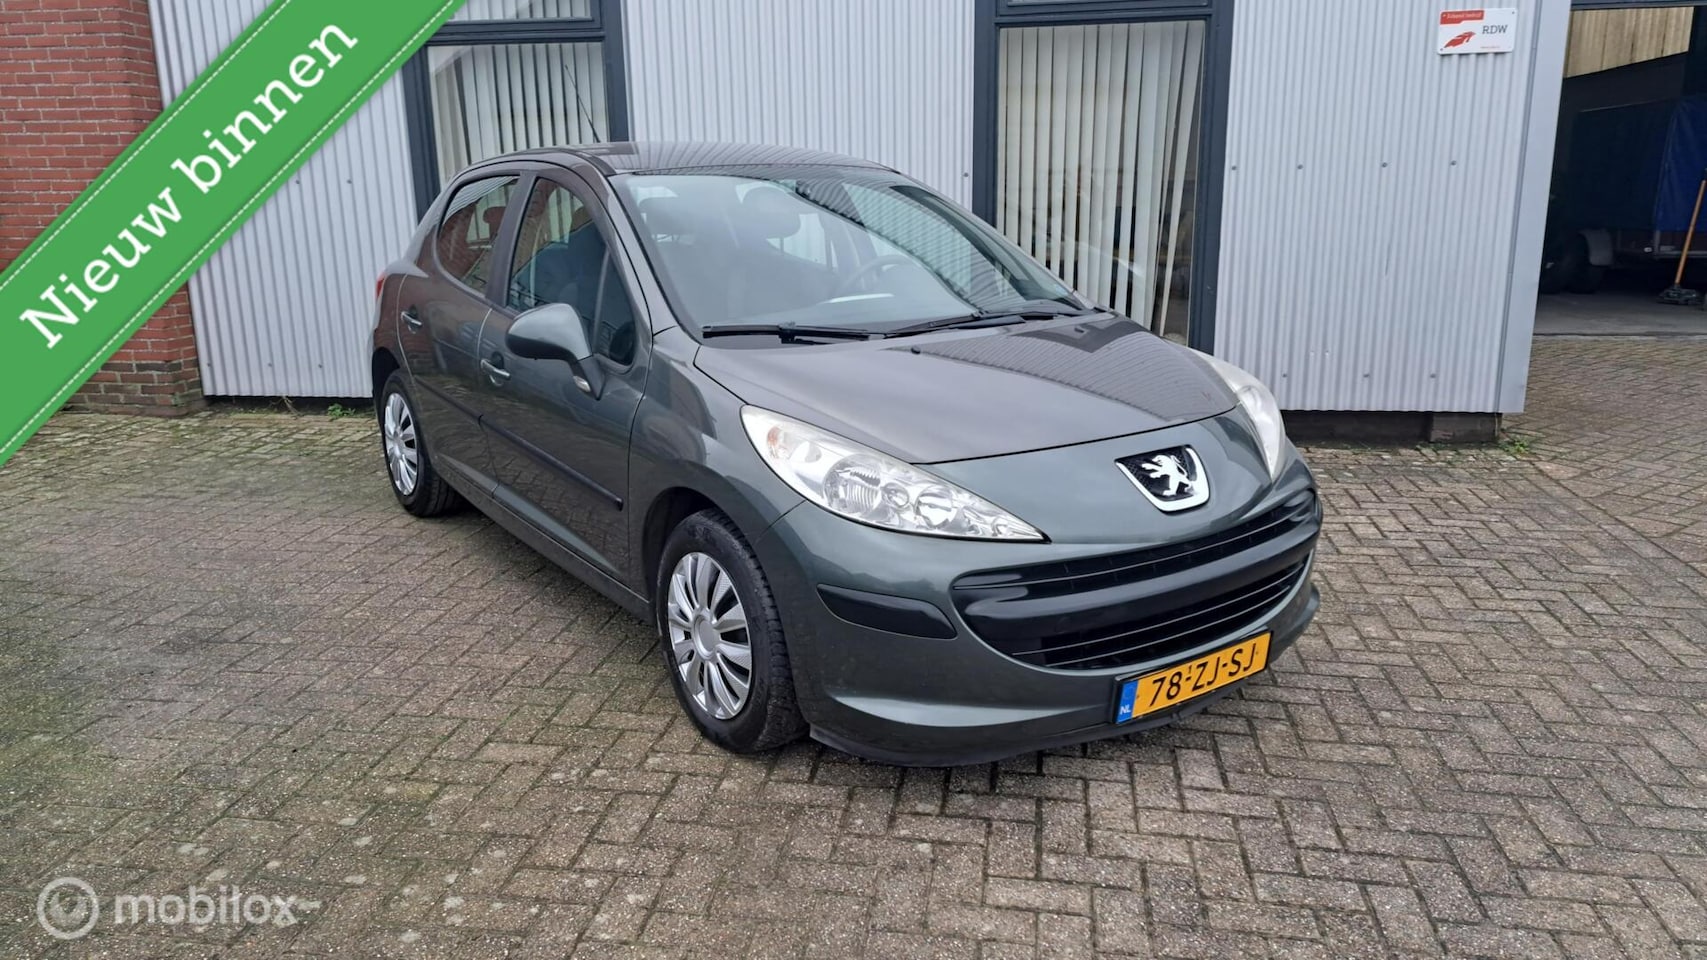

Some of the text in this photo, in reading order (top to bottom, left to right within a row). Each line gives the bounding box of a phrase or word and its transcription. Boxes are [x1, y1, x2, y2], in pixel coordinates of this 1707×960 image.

[1482, 25, 1508, 34] RDW
[1149, 643, 1256, 707] 78-ZJ-SJ
[1119, 704, 1131, 715] NL
